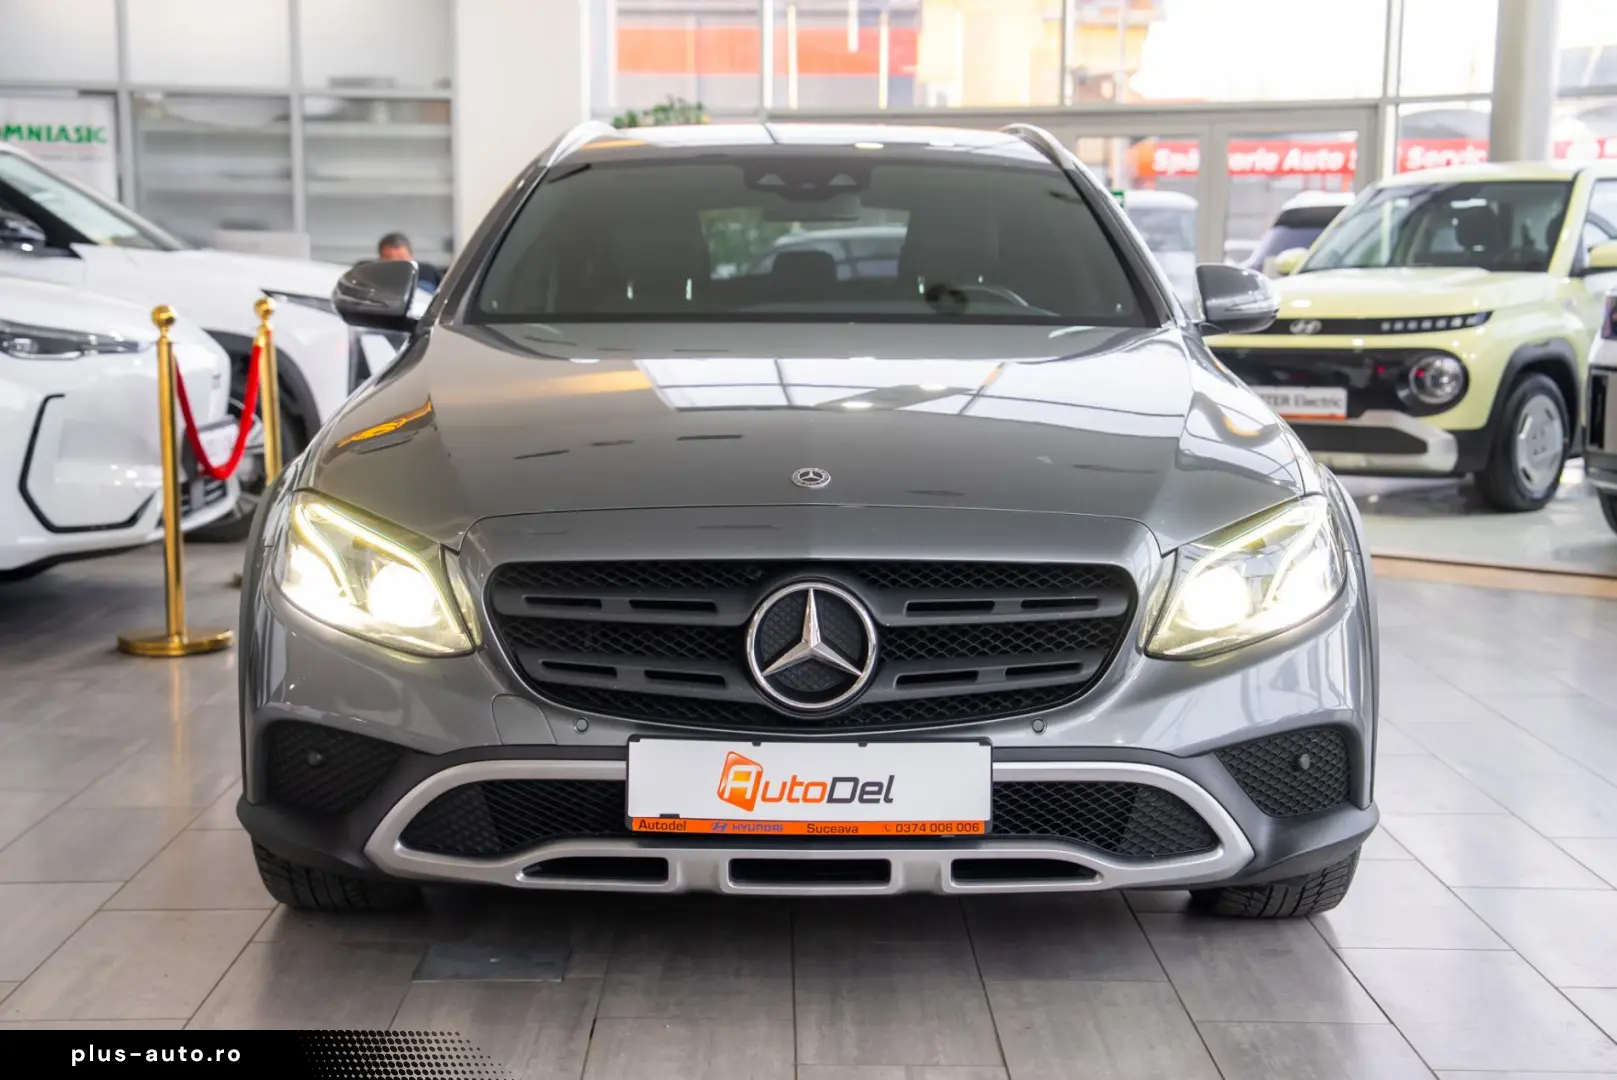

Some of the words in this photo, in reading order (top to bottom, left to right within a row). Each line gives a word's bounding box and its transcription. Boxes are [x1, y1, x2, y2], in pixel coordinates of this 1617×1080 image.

[1282, 148, 1345, 171] Auto
[1293, 394, 1344, 409] Electric
[718, 756, 895, 807] AutoDel
[638, 819, 686, 831] Autodel
[732, 823, 784, 832] HYUNDAI
[806, 823, 859, 834] Suceava
[895, 823, 926, 833] 0374
[930, 823, 953, 832] 006
[956, 822, 979, 832] 006
